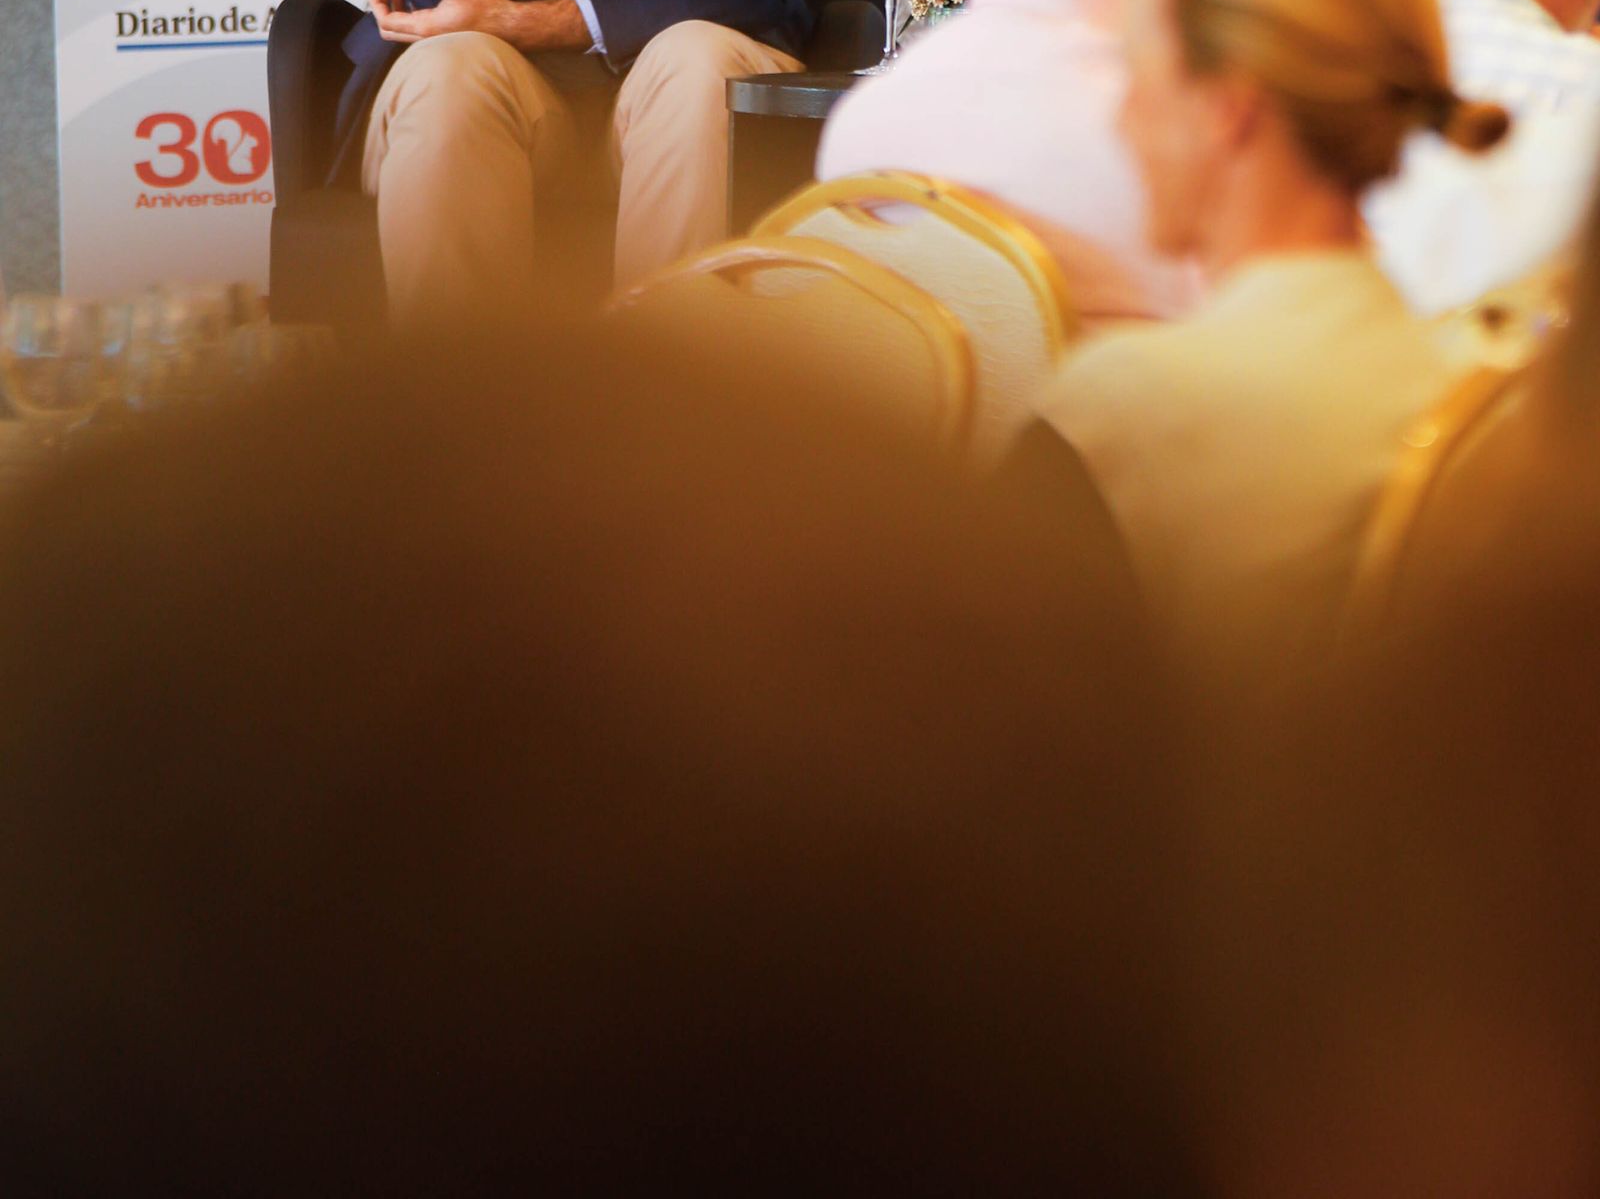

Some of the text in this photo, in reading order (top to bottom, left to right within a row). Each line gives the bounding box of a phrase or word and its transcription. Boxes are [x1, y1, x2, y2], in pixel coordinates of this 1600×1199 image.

[116, 8, 216, 38] Diario
[134, 110, 272, 189] 30
[135, 188, 274, 210] Aniversario
